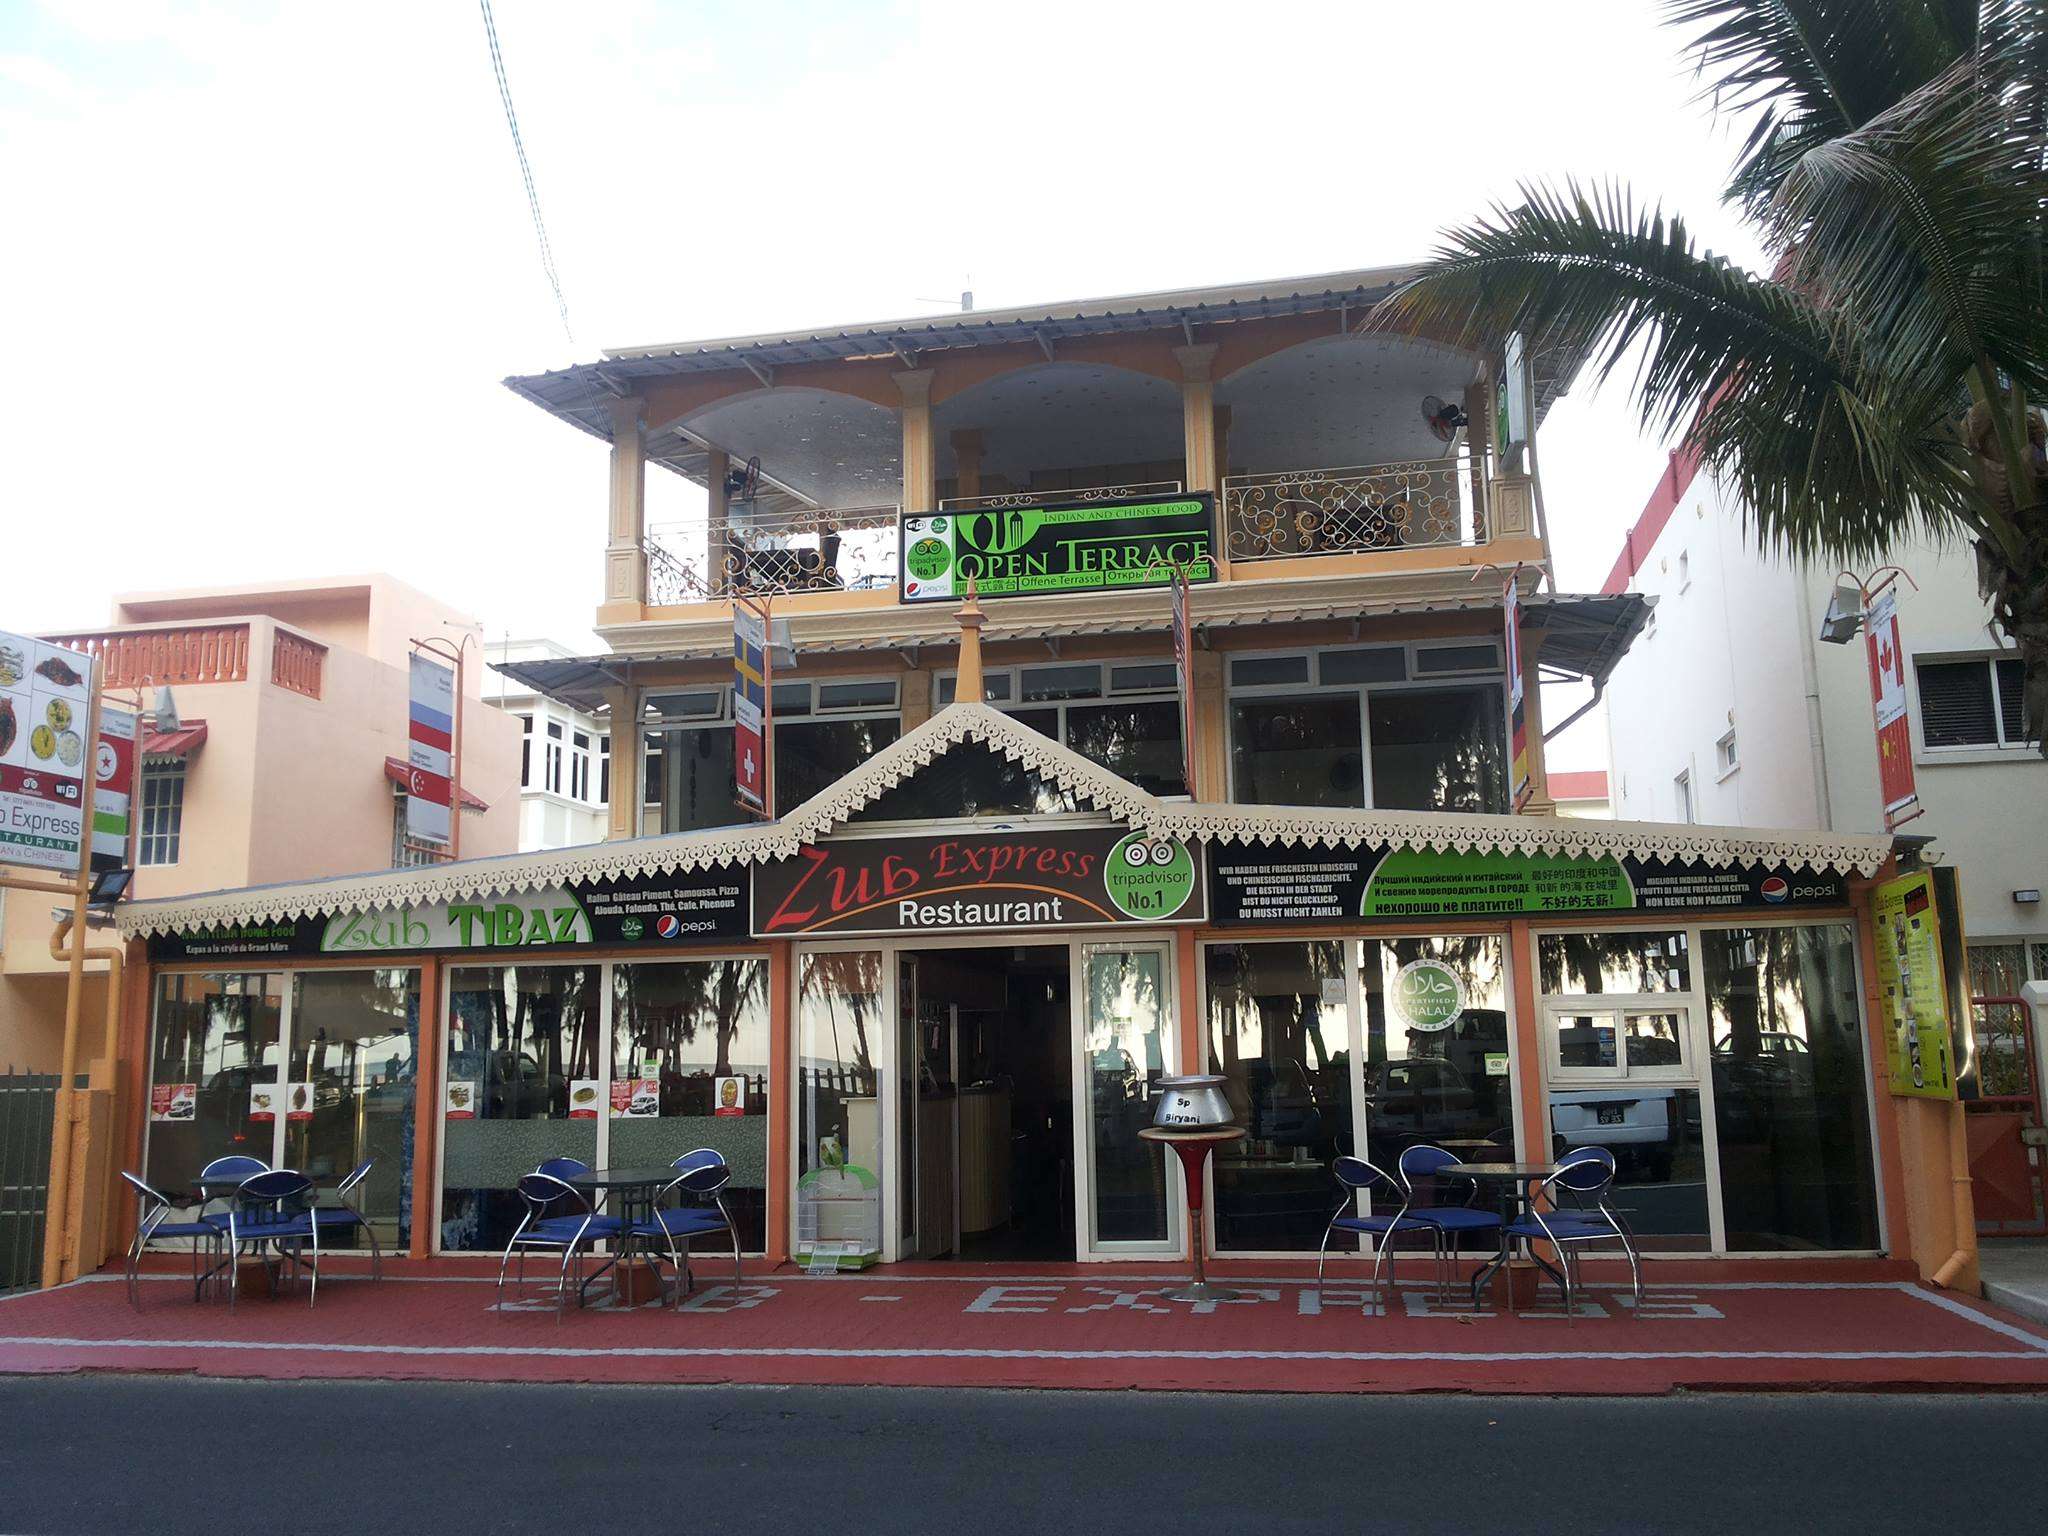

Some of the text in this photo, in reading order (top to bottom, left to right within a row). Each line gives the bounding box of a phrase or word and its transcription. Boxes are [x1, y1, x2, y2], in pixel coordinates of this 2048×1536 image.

[1044, 504, 1198, 522] INDIAN AND CHINESE FOOD
[956, 530, 1209, 580] OPEN TERRACE
[917, 564, 937, 576] No.1
[1021, 575, 1100, 587] Offene Terrasse
[12, 806, 80, 836] Express
[1219, 862, 1358, 875] WIR HABEN DIE FRISCHESTEN INDISCHEN
[1113, 871, 1187, 887] tripadvisor
[1227, 877, 1242, 885] UND
[1243, 875, 1294, 885] CHINESISCHEN
[1374, 875, 1410, 885] Лучший
[1464, 875, 1472, 883] и
[1472, 872, 1523, 882] китайский
[1646, 877, 1678, 885] MIGLIORE
[1679, 876, 1707, 884] INDIANO
[1714, 874, 1738, 882] CINESE
[719, 886, 739, 896] Pizza
[763, 842, 1095, 933] Zub Express
[1246, 884, 1332, 895] DIE BESTEN IN DER STADT
[1496, 883, 1530, 894] ГОРОДЕ
[1640, 887, 1663, 895] FRUTTI
[1664, 886, 1672, 894] DI
[1673, 886, 1691, 894] MARE
[1692, 885, 1720, 893] FRESCHI
[1721, 884, 1729, 892] IN
[1792, 884, 1836, 898] pepsi
[1127, 890, 1163, 910] No.1
[1242, 897, 1259, 906] BIST
[1260, 896, 1270, 905] DU
[1271, 896, 1293, 905] NICHT
[1375, 898, 1523, 914] нехорошо не платите!!
[1645, 895, 1742, 907] NON BENE NON PAGATE!!
[899, 896, 1063, 926] Restaurant
[1239, 909, 1251, 919] DU
[1252, 908, 1282, 918] MUSST
[1284, 907, 1310, 917] NICHT
[331, 908, 431, 949] Zub
[681, 919, 716, 933] pepsi
[1403, 971, 1453, 995] حلال
[1408, 1006, 1450, 1016] HALAL
[1177, 1098, 1191, 1107] Sp
[1165, 1113, 1201, 1124] Biryani
